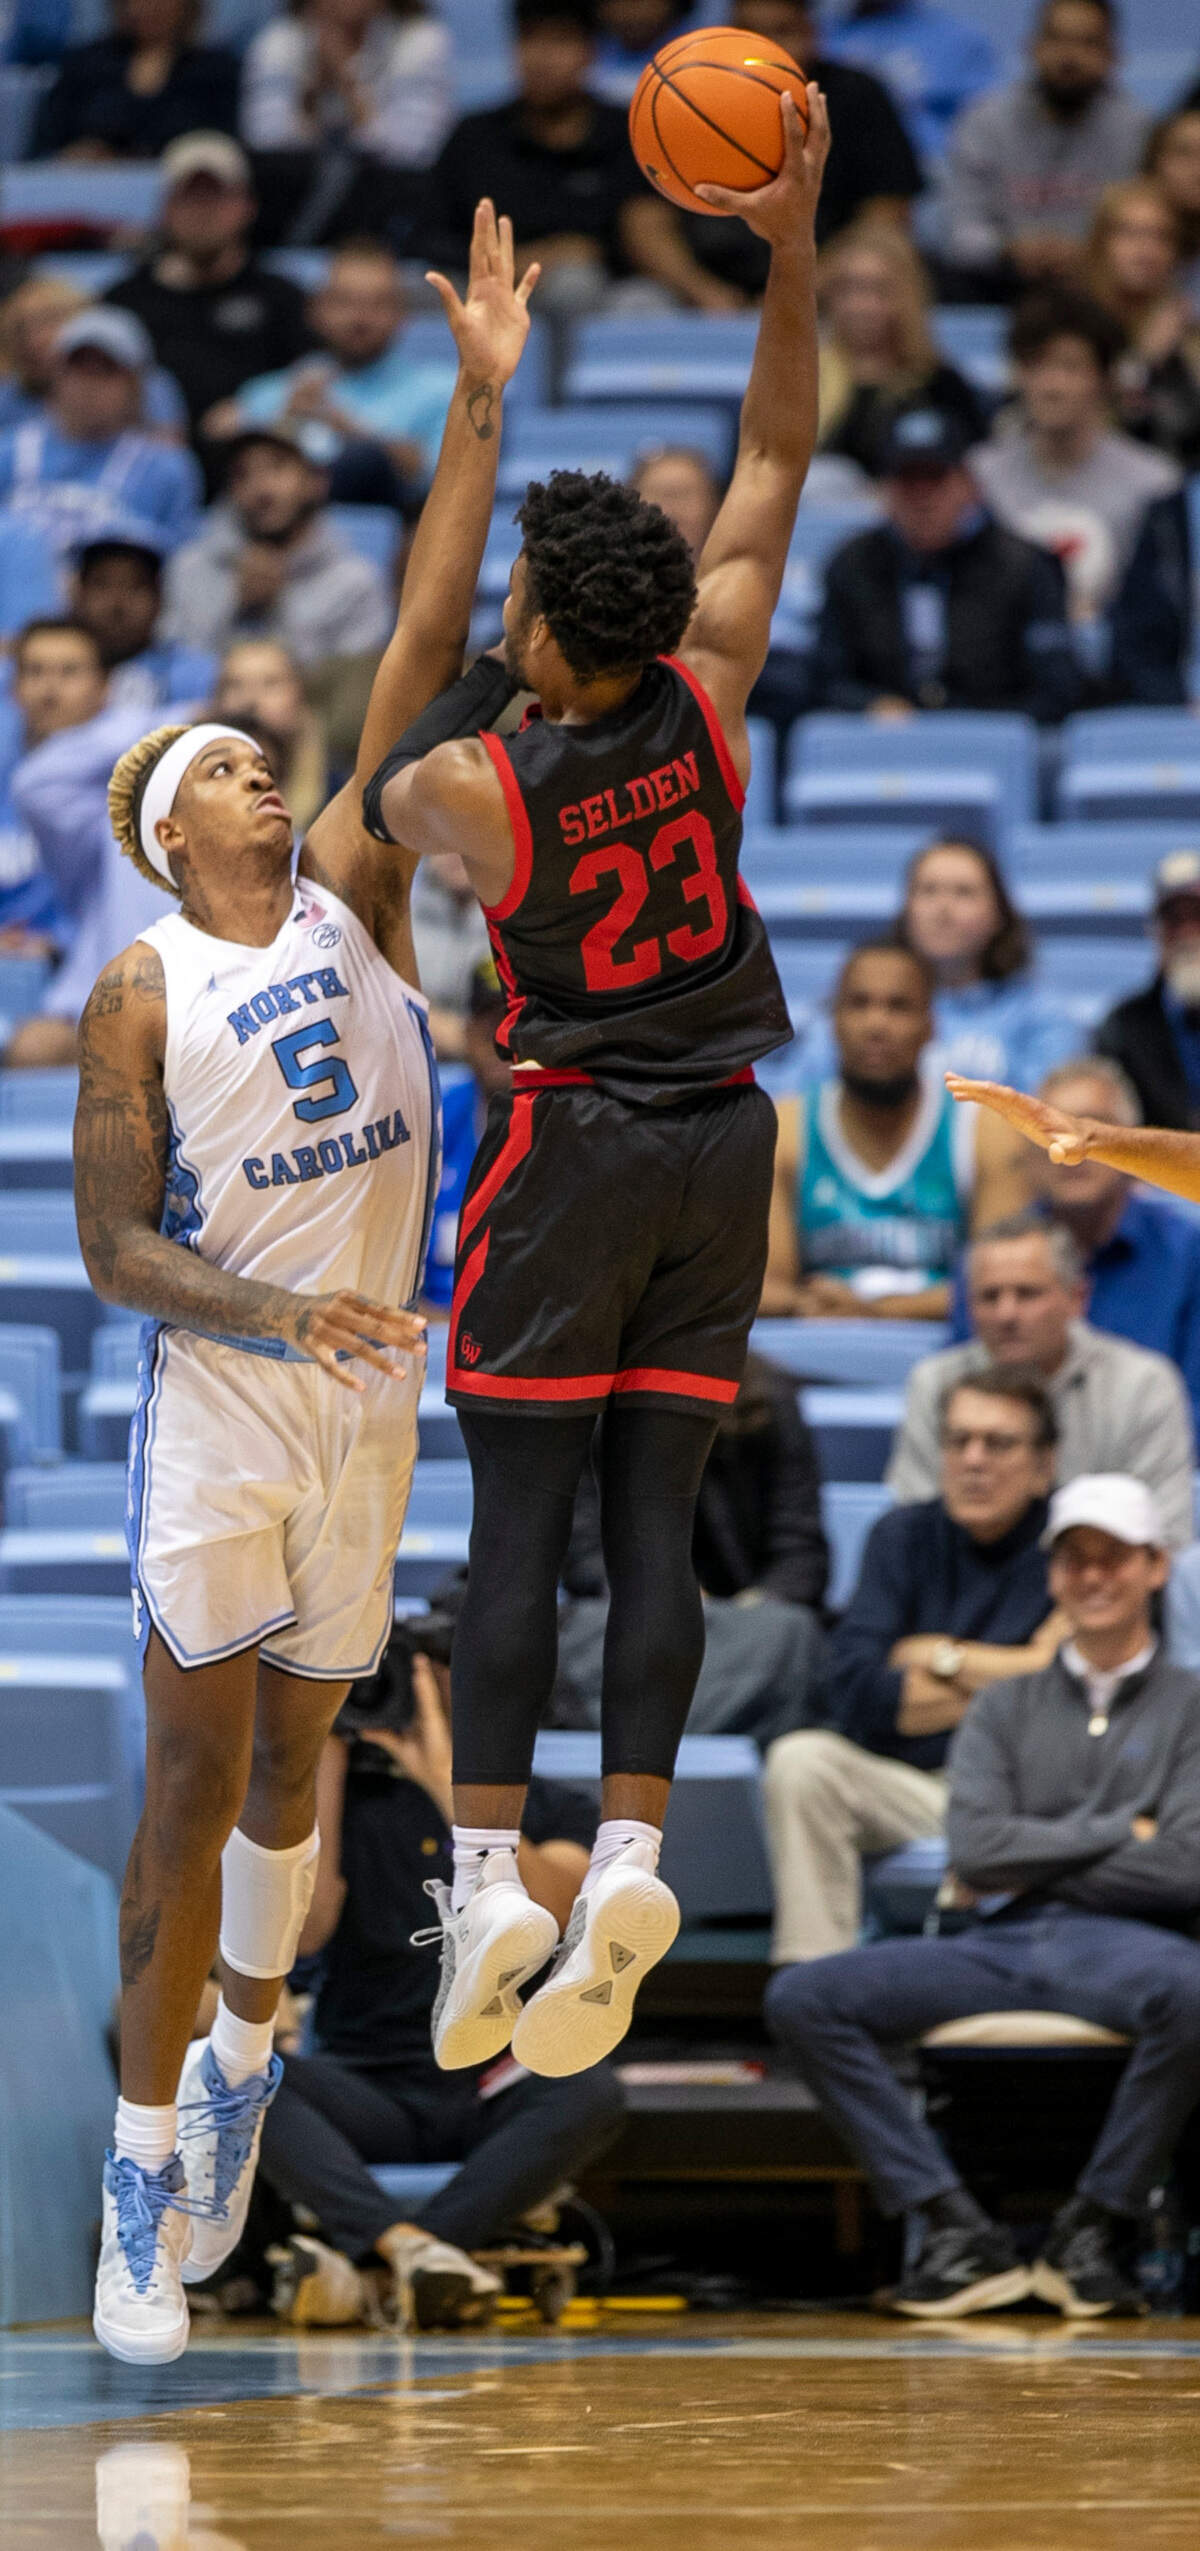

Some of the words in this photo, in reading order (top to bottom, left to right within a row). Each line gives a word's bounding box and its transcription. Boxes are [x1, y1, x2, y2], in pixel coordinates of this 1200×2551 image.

[558, 751, 700, 845] SELDEN
[569, 809, 728, 991] 23
[227, 967, 350, 1045] NORTH
[271, 1017, 359, 1123] 5
